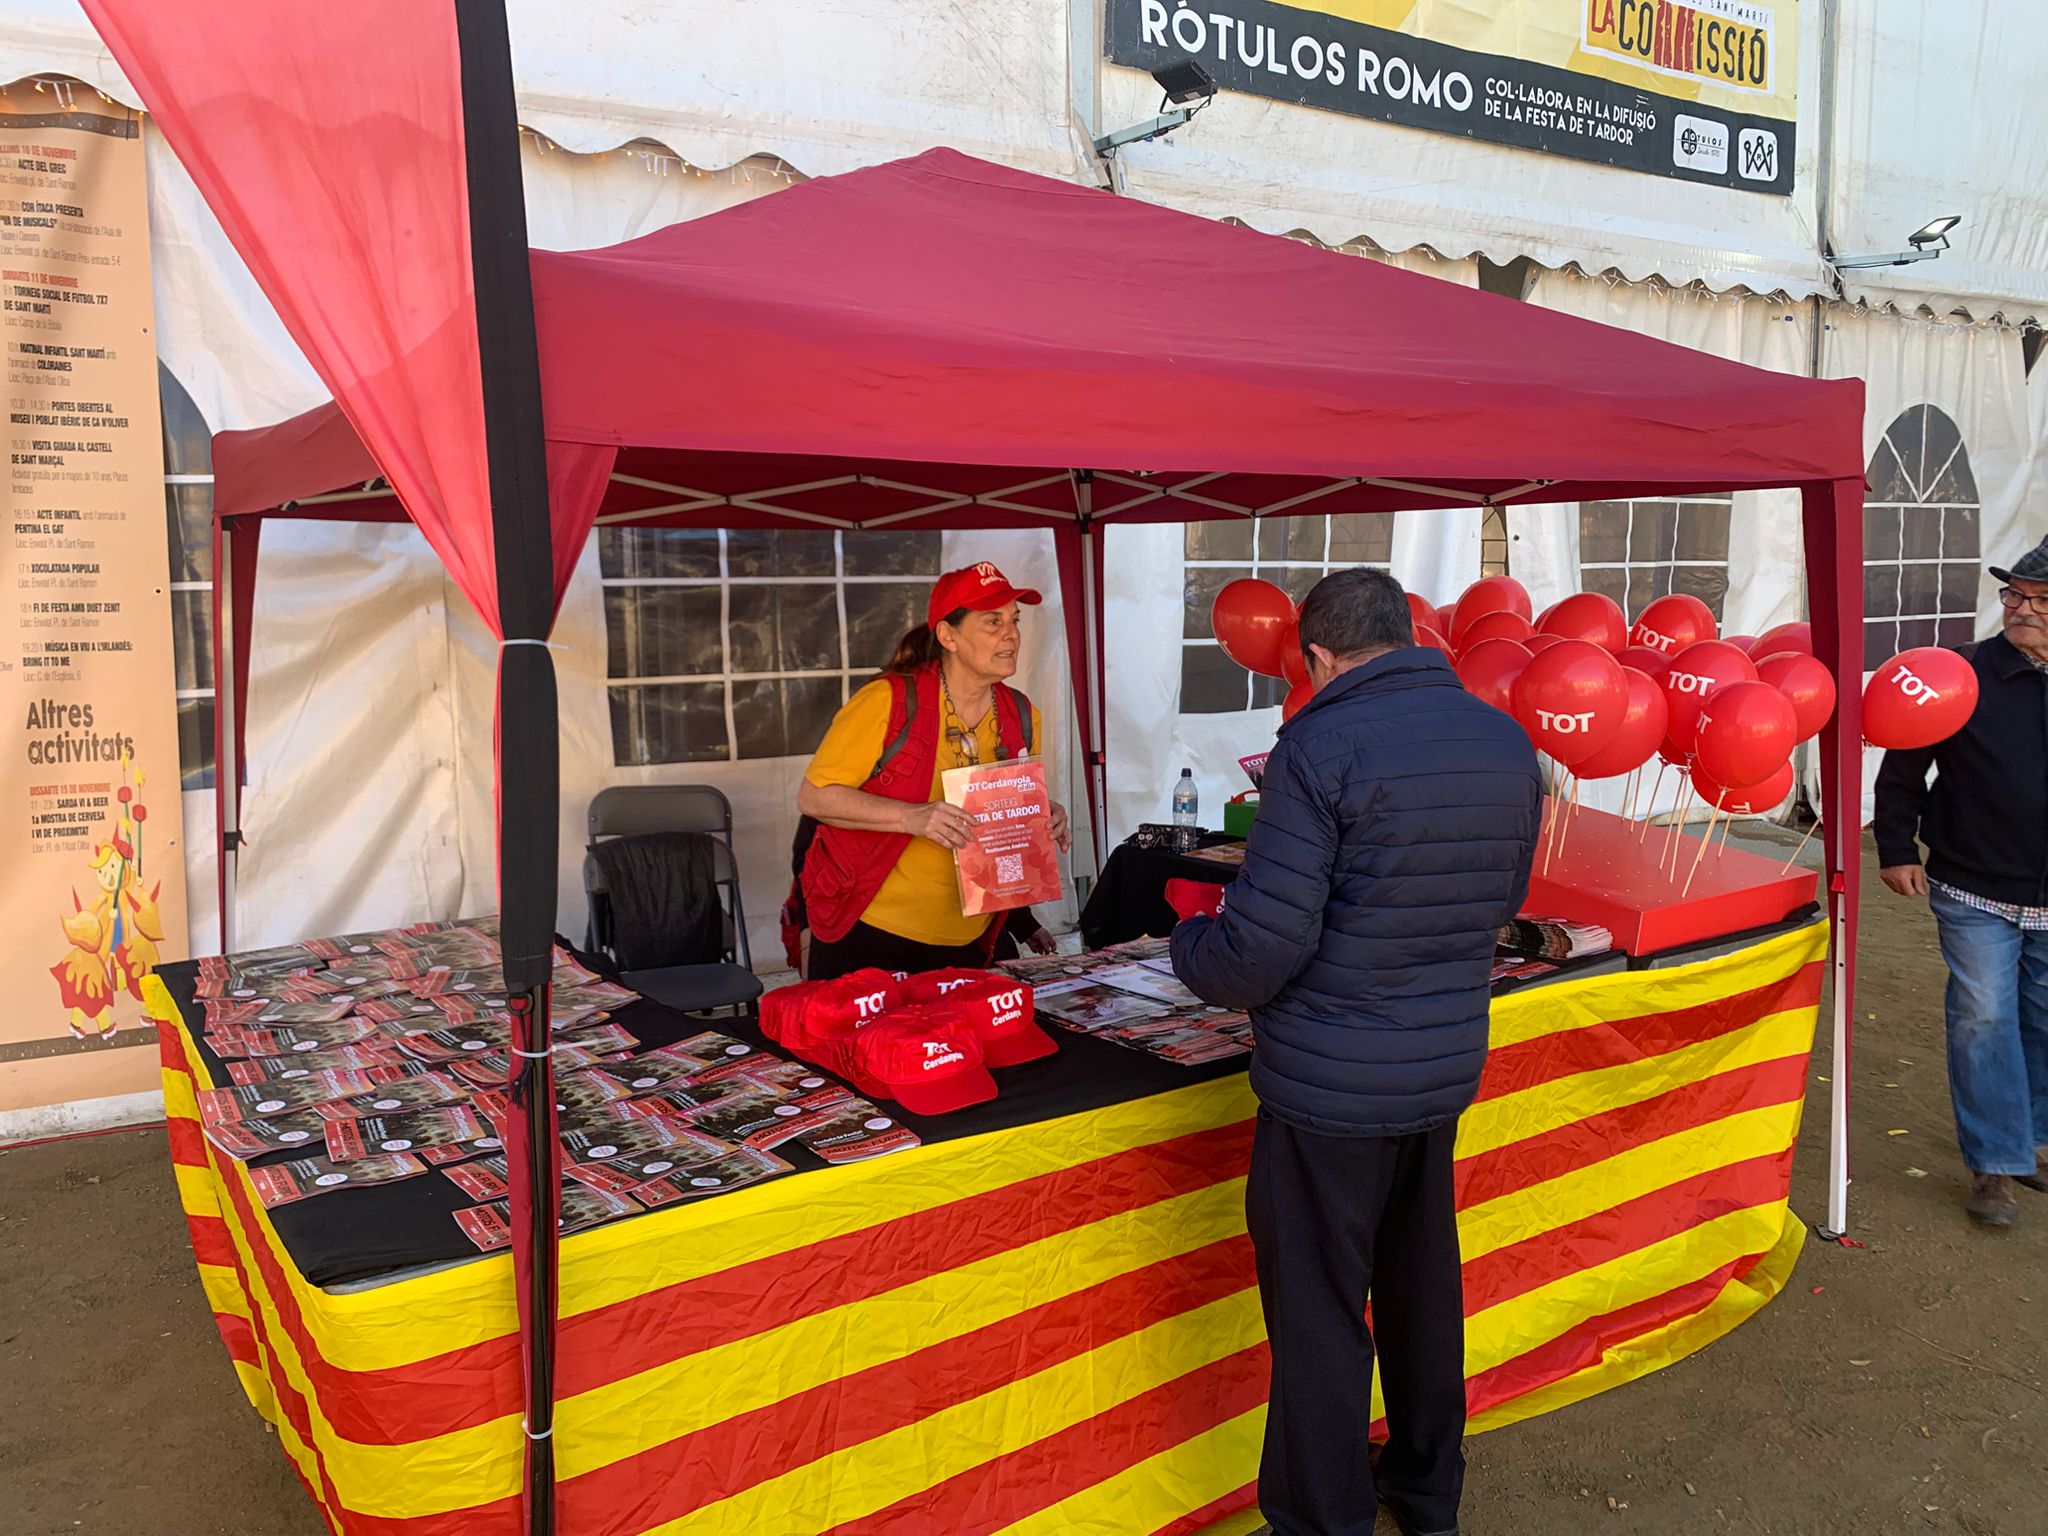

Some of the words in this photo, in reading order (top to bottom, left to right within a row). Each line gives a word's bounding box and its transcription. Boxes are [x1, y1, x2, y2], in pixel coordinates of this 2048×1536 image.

[1358, 48, 1474, 112] ROMO
[1576, 96, 1592, 115] EN
[1595, 100, 1610, 120] LA
[1613, 104, 1656, 130] DIFUSIÓ
[1484, 98, 1501, 118] DE
[1504, 102, 1522, 122] LA
[1525, 106, 1566, 131] FESTA
[1569, 116, 1584, 135] DE
[1586, 120, 1634, 146] TARDOR
[31, 145, 40, 156] DE
[18, 158, 34, 171] ACTE
[35, 160, 48, 172] DEL
[49, 162, 66, 174] GREC
[21, 201, 35, 212] COR
[54, 203, 84, 218] PRESENTA
[13, 216, 22, 227] DE
[31, 273, 38, 283] 11
[40, 273, 48, 285] DE
[13, 285, 41, 299] TORNEIG
[42, 288, 62, 302] SOCIAL
[62, 291, 71, 303] DE
[72, 292, 96, 305] FUTBOL
[96, 295, 109, 305] 7X7
[4, 299, 13, 311] DE
[15, 301, 31, 313] SANT
[33, 301, 52, 315] MARTÍ
[20, 342, 43, 355] MATINAL
[44, 344, 70, 358] INFANTIL
[70, 346, 87, 358] SANT
[87, 346, 106, 359] MARTÍ
[37, 359, 72, 372] COLORAINES
[52, 400, 76, 412] PORTES
[77, 402, 104, 413] OBERTES
[105, 403, 114, 414] AL
[10, 413, 31, 424] MUSEU
[36, 414, 59, 426] POBLAT
[82, 416, 91, 427] DE
[92, 417, 101, 427] CA
[32, 440, 52, 451] VISITA
[53, 441, 76, 452] GUIADA
[77, 442, 86, 452] AL
[86, 442, 113, 453] CASTELL
[11, 453, 20, 465] DE
[21, 454, 37, 465] SANT
[38, 455, 65, 468] MARÇAL
[37, 509, 53, 520] ACTE
[54, 509, 82, 521] INFANTIL
[14, 523, 42, 534] PENTINA
[43, 524, 51, 534] EL
[52, 524, 64, 534] GAT
[31, 563, 71, 574] XOCOLATADA
[72, 563, 100, 574] POPULAR
[33, 602, 40, 613] FI
[41, 602, 50, 613] DE
[50, 602, 70, 613] FESTA
[71, 602, 86, 613] AMB
[86, 602, 102, 613] DUET
[103, 602, 121, 613] ZENIT
[1635, 622, 1677, 652] TOT
[44, 640, 69, 652] MÚSICA
[70, 642, 79, 652] EN
[80, 642, 90, 652] VIU
[91, 642, 96, 652] A
[22, 657, 42, 667] BRING
[43, 657, 50, 667] IT
[51, 657, 59, 667] TO
[60, 656, 70, 667] ME
[1668, 670, 1715, 697] TOT
[1891, 665, 1941, 706] TOT
[26, 698, 94, 730] Altres
[1536, 709, 1595, 734] TOT
[28, 730, 135, 765] activitats
[1244, 757, 1264, 768] TOT
[30, 784, 59, 796] DISSABTE
[69, 784, 77, 794] DE
[78, 782, 111, 794] NOVEMBRE
[981, 775, 1031, 791] Cerdanyola
[57, 798, 78, 809] SARDA
[79, 798, 85, 808] VI
[92, 796, 109, 807] BEER
[984, 797, 1017, 812] SORTEIG
[40, 813, 67, 824] MOSTRA
[68, 812, 77, 823] DE
[78, 810, 106, 822] CERVESA
[991, 810, 1004, 821] DE
[1004, 804, 1041, 818] TARDOR
[36, 828, 42, 838] VI
[43, 828, 52, 838] DE
[53, 826, 89, 838] PROXIMITAT
[987, 988, 1023, 1014] TOT
